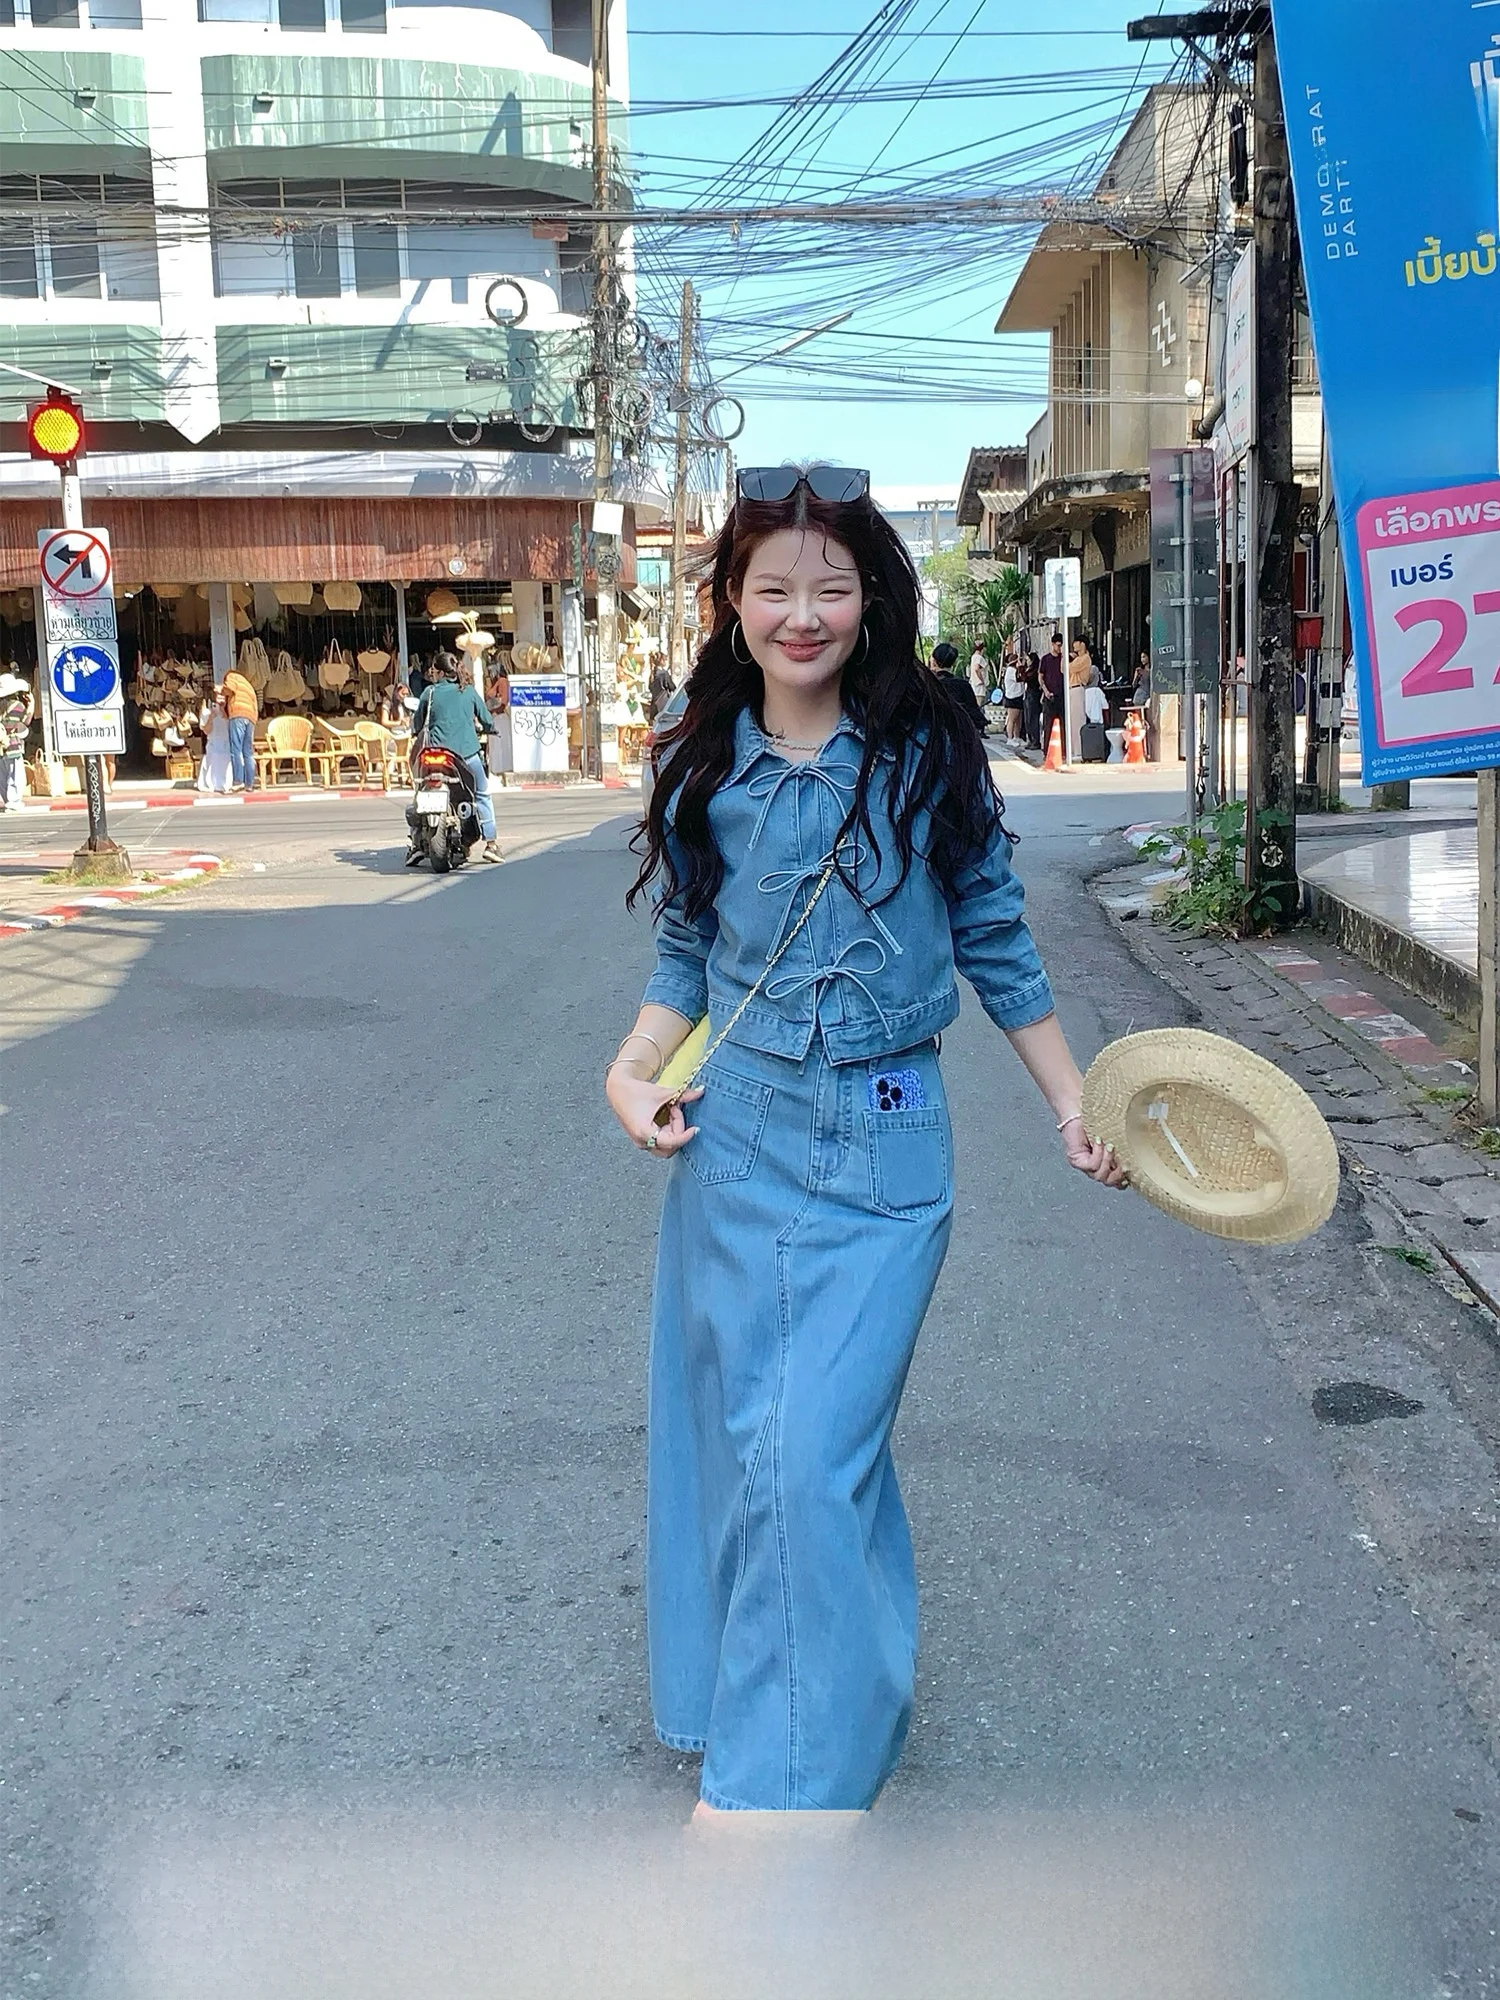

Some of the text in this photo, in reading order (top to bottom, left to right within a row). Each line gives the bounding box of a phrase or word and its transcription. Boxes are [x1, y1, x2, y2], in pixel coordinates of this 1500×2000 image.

[1390, 553, 1454, 588] เบอร์
[50, 608, 112, 631] ห้ามเลี้ยวซ้าย
[63, 718, 117, 740] ให้เลี้ยวขวา
